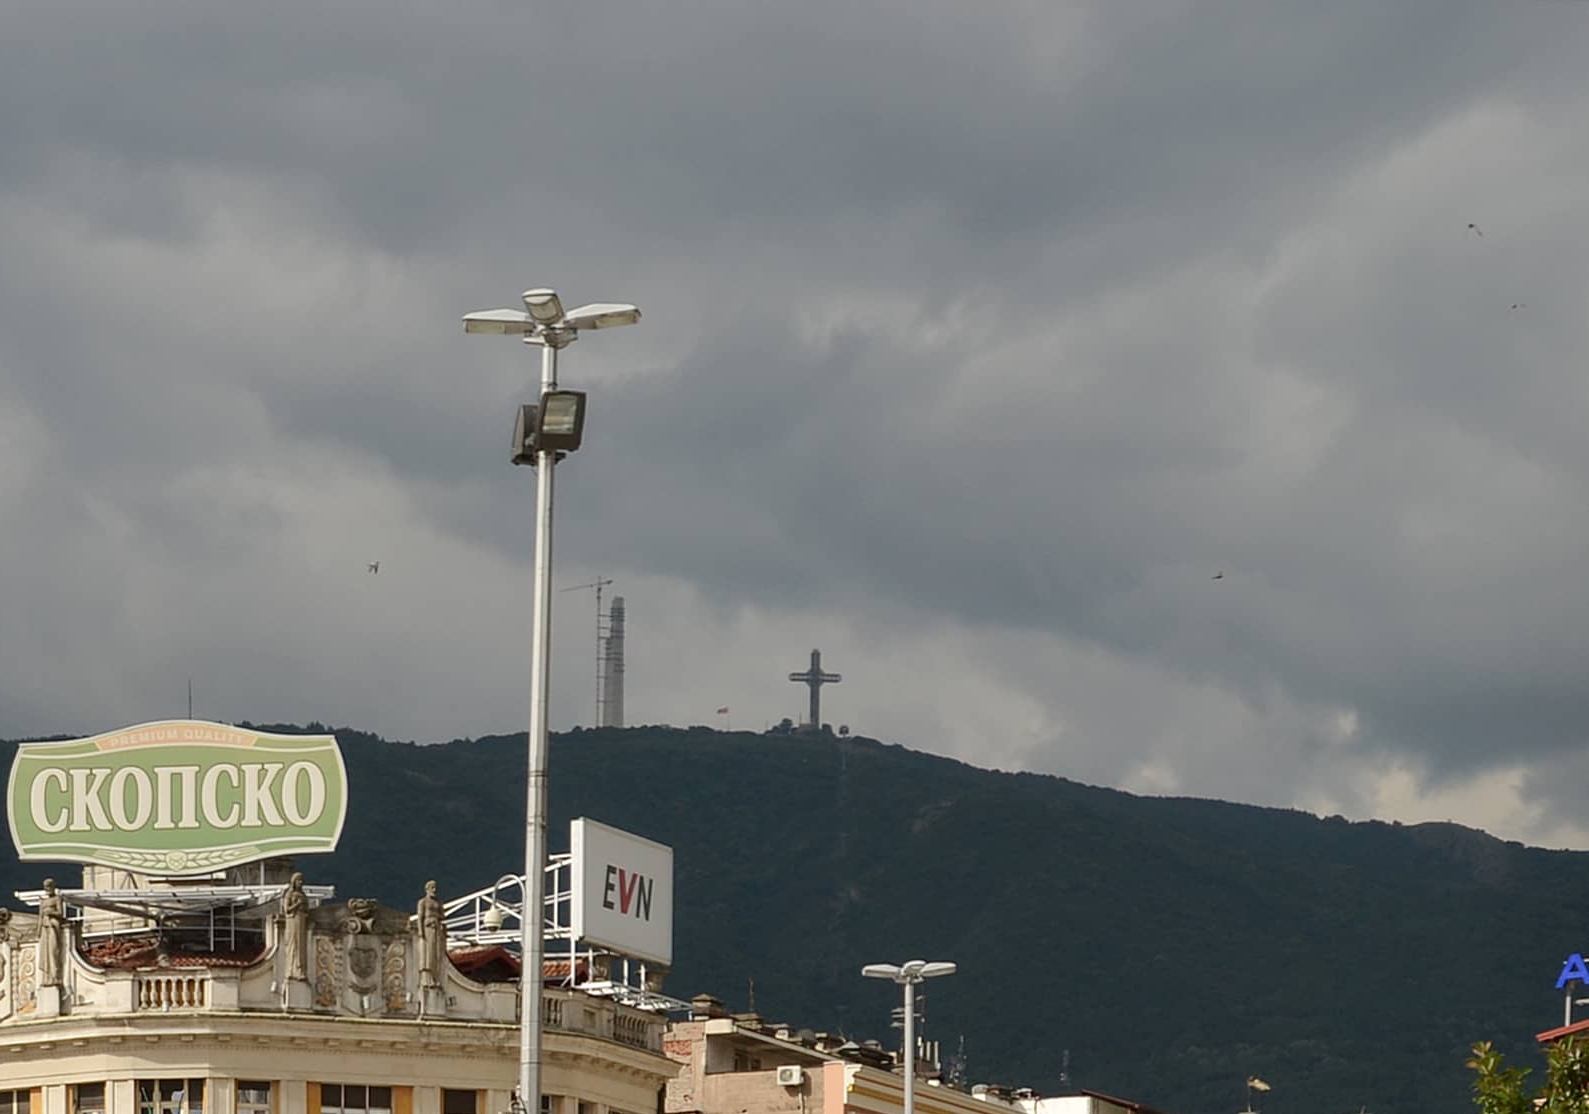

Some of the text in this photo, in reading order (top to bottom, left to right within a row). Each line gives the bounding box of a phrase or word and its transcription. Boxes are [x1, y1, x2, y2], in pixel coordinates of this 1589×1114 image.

[111, 729, 244, 747] PREMIUM QUALITY
[30, 761, 327, 833] СКОПСКО
[602, 864, 654, 921] EVN
